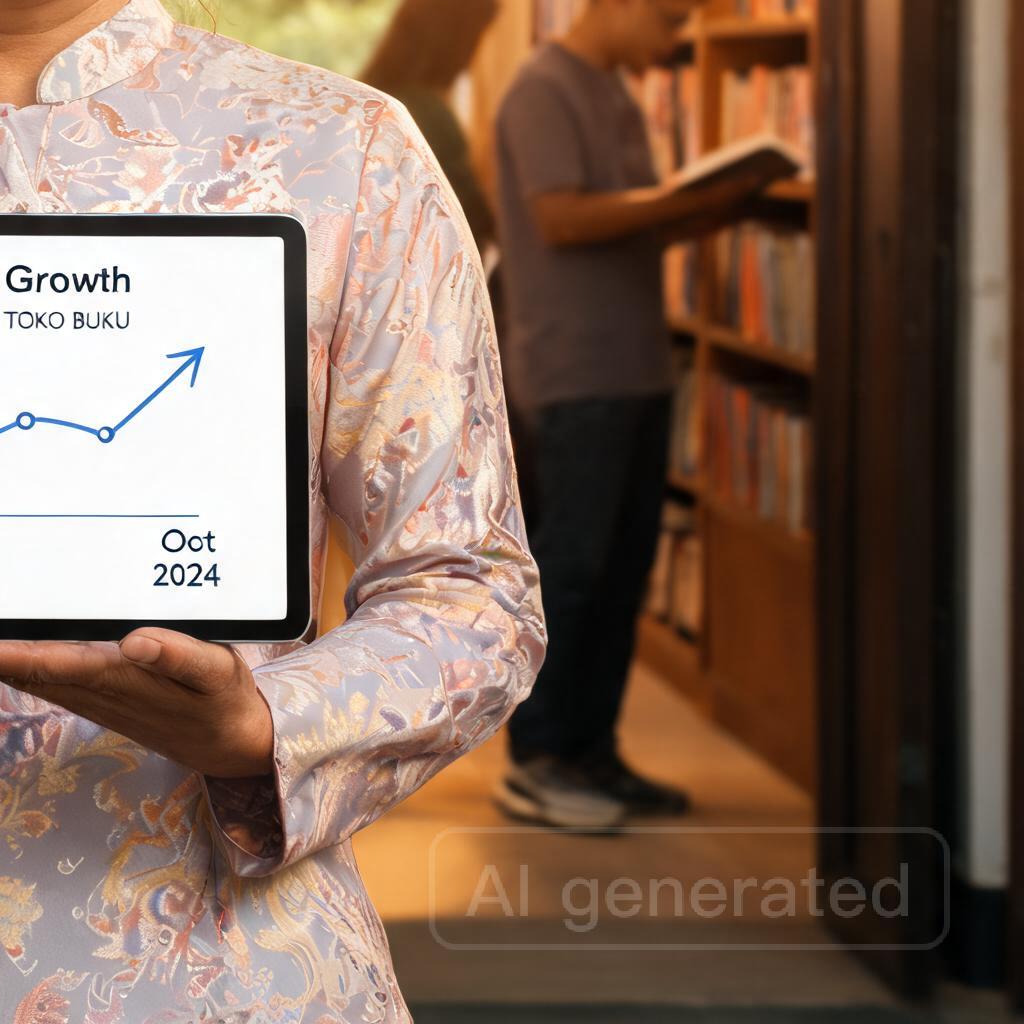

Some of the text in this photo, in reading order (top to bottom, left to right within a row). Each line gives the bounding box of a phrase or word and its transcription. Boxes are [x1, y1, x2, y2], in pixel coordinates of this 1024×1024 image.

[5, 264, 132, 294] Growth
[3, 310, 65, 330] TOKO
[72, 311, 131, 330] BUKU
[152, 562, 221, 588] 2024
